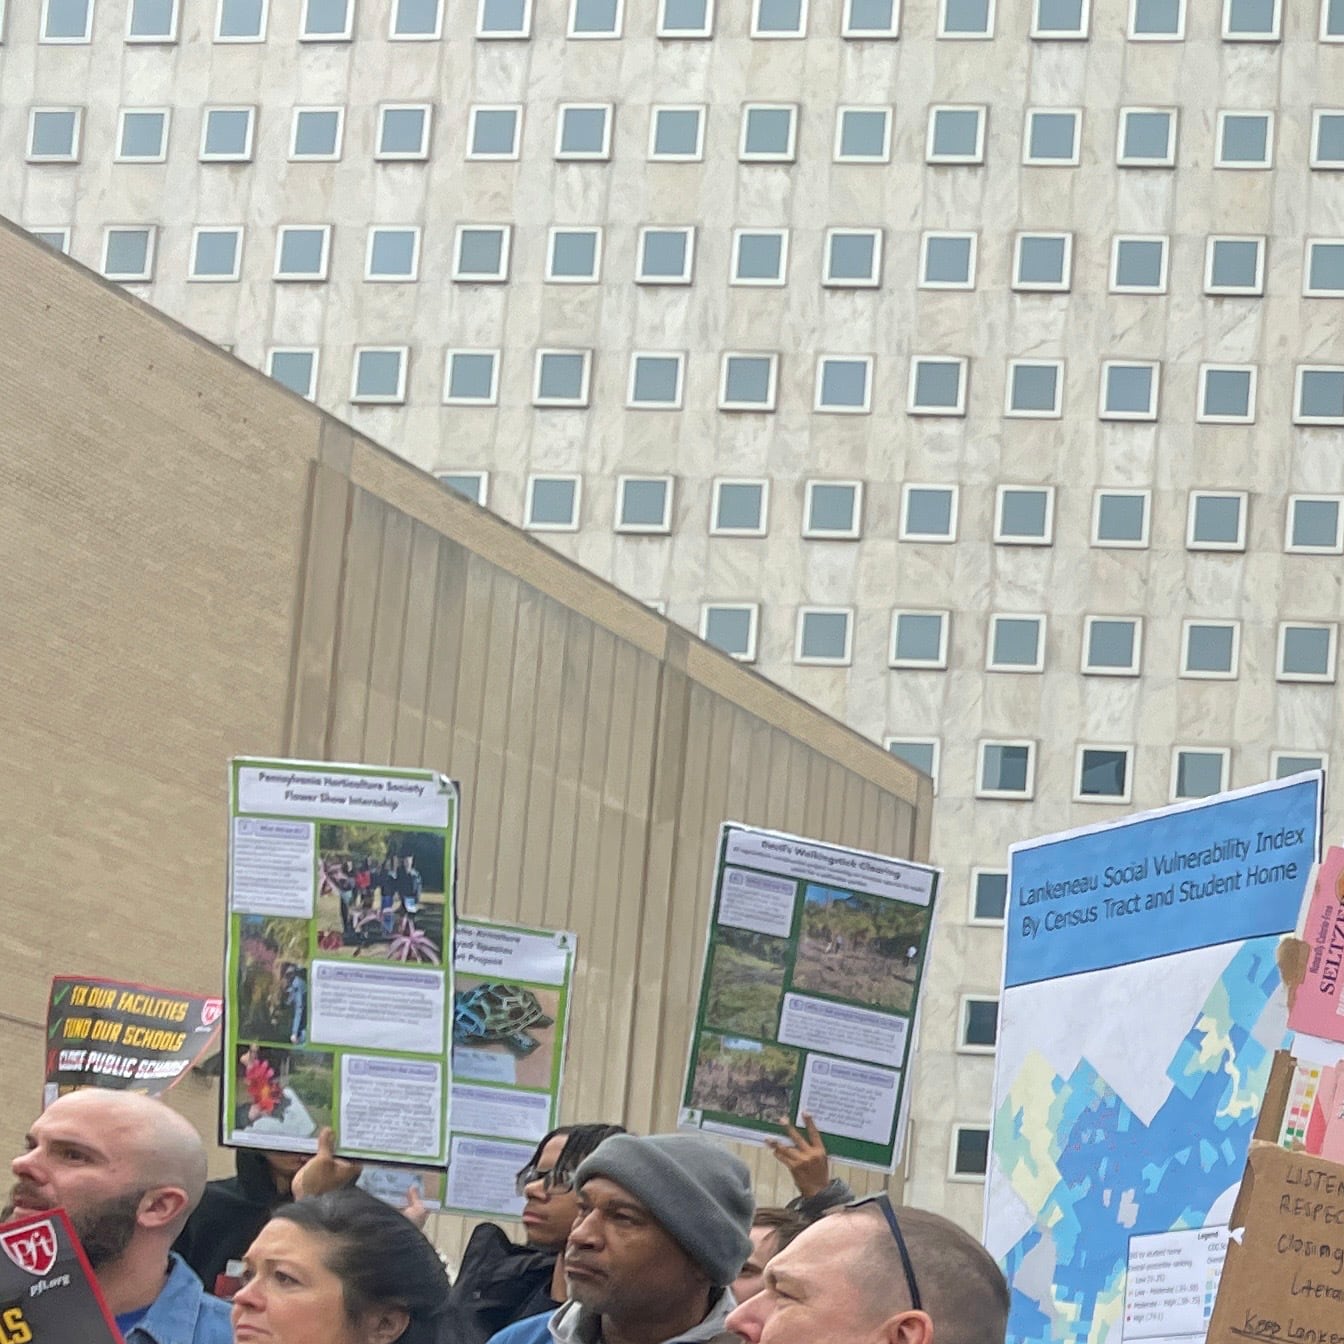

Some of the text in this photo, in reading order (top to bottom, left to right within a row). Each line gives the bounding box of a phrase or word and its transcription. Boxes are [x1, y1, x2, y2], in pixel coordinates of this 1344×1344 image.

[284, 789, 318, 801] Flower
[348, 796, 400, 812] Internship
[386, 780, 424, 797] Society
[1019, 826, 1305, 907] Lankeneau Social Vulnerability Index
[1021, 861, 1298, 940] By Census Tract and Student Home
[70, 985, 190, 1022] FIX OUR FACILITIES
[63, 1017, 188, 1052] FUND OUR SCHOOLS
[85, 1050, 138, 1078] PUBLIC
[30, 1272, 71, 1297] pft.org
